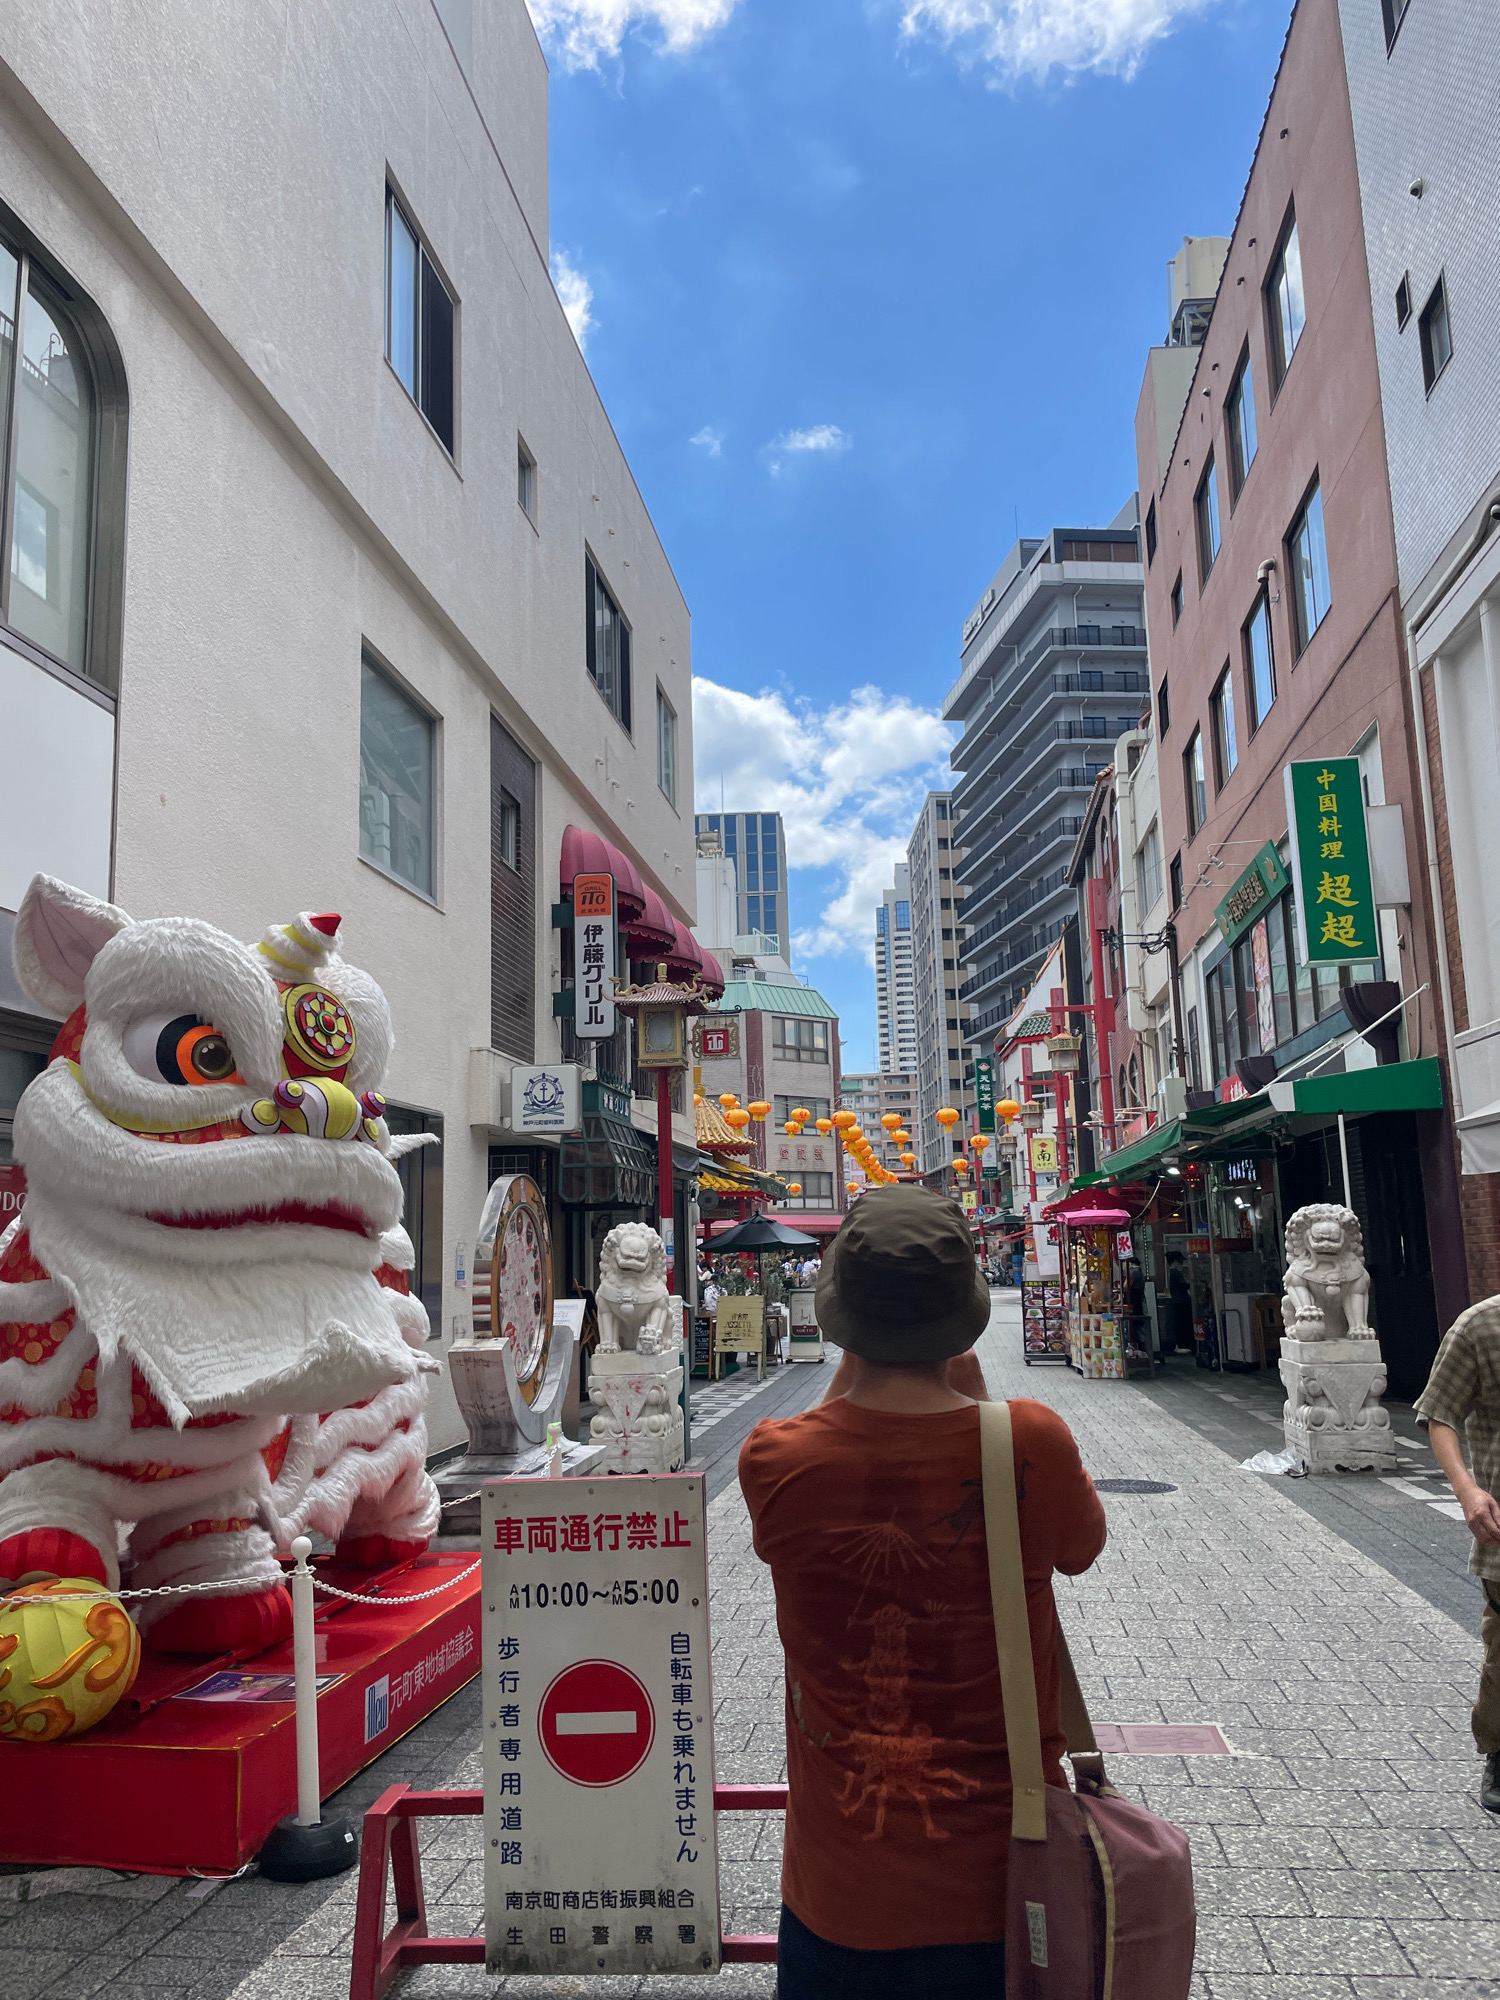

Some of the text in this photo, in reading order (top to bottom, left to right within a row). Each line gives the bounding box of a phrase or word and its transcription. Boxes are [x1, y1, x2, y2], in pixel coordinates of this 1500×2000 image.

[1316, 768, 1364, 949] 中国料理 超超
[582, 924, 604, 1026] 伊藤グリル
[1037, 1149, 1051, 1162] 南
[1118, 1235, 1131, 1252] 氷
[494, 1510, 692, 1555] 車両通行禁止
[390, 1624, 474, 1714] 元町東地域協議会
[497, 1636, 522, 1866] 歩行者専用道路
[670, 1631, 699, 1864] 自転車も乗れません
[505, 1888, 695, 1911] 南京町商店街振興組合
[506, 1924, 696, 1946] 生田警察署
